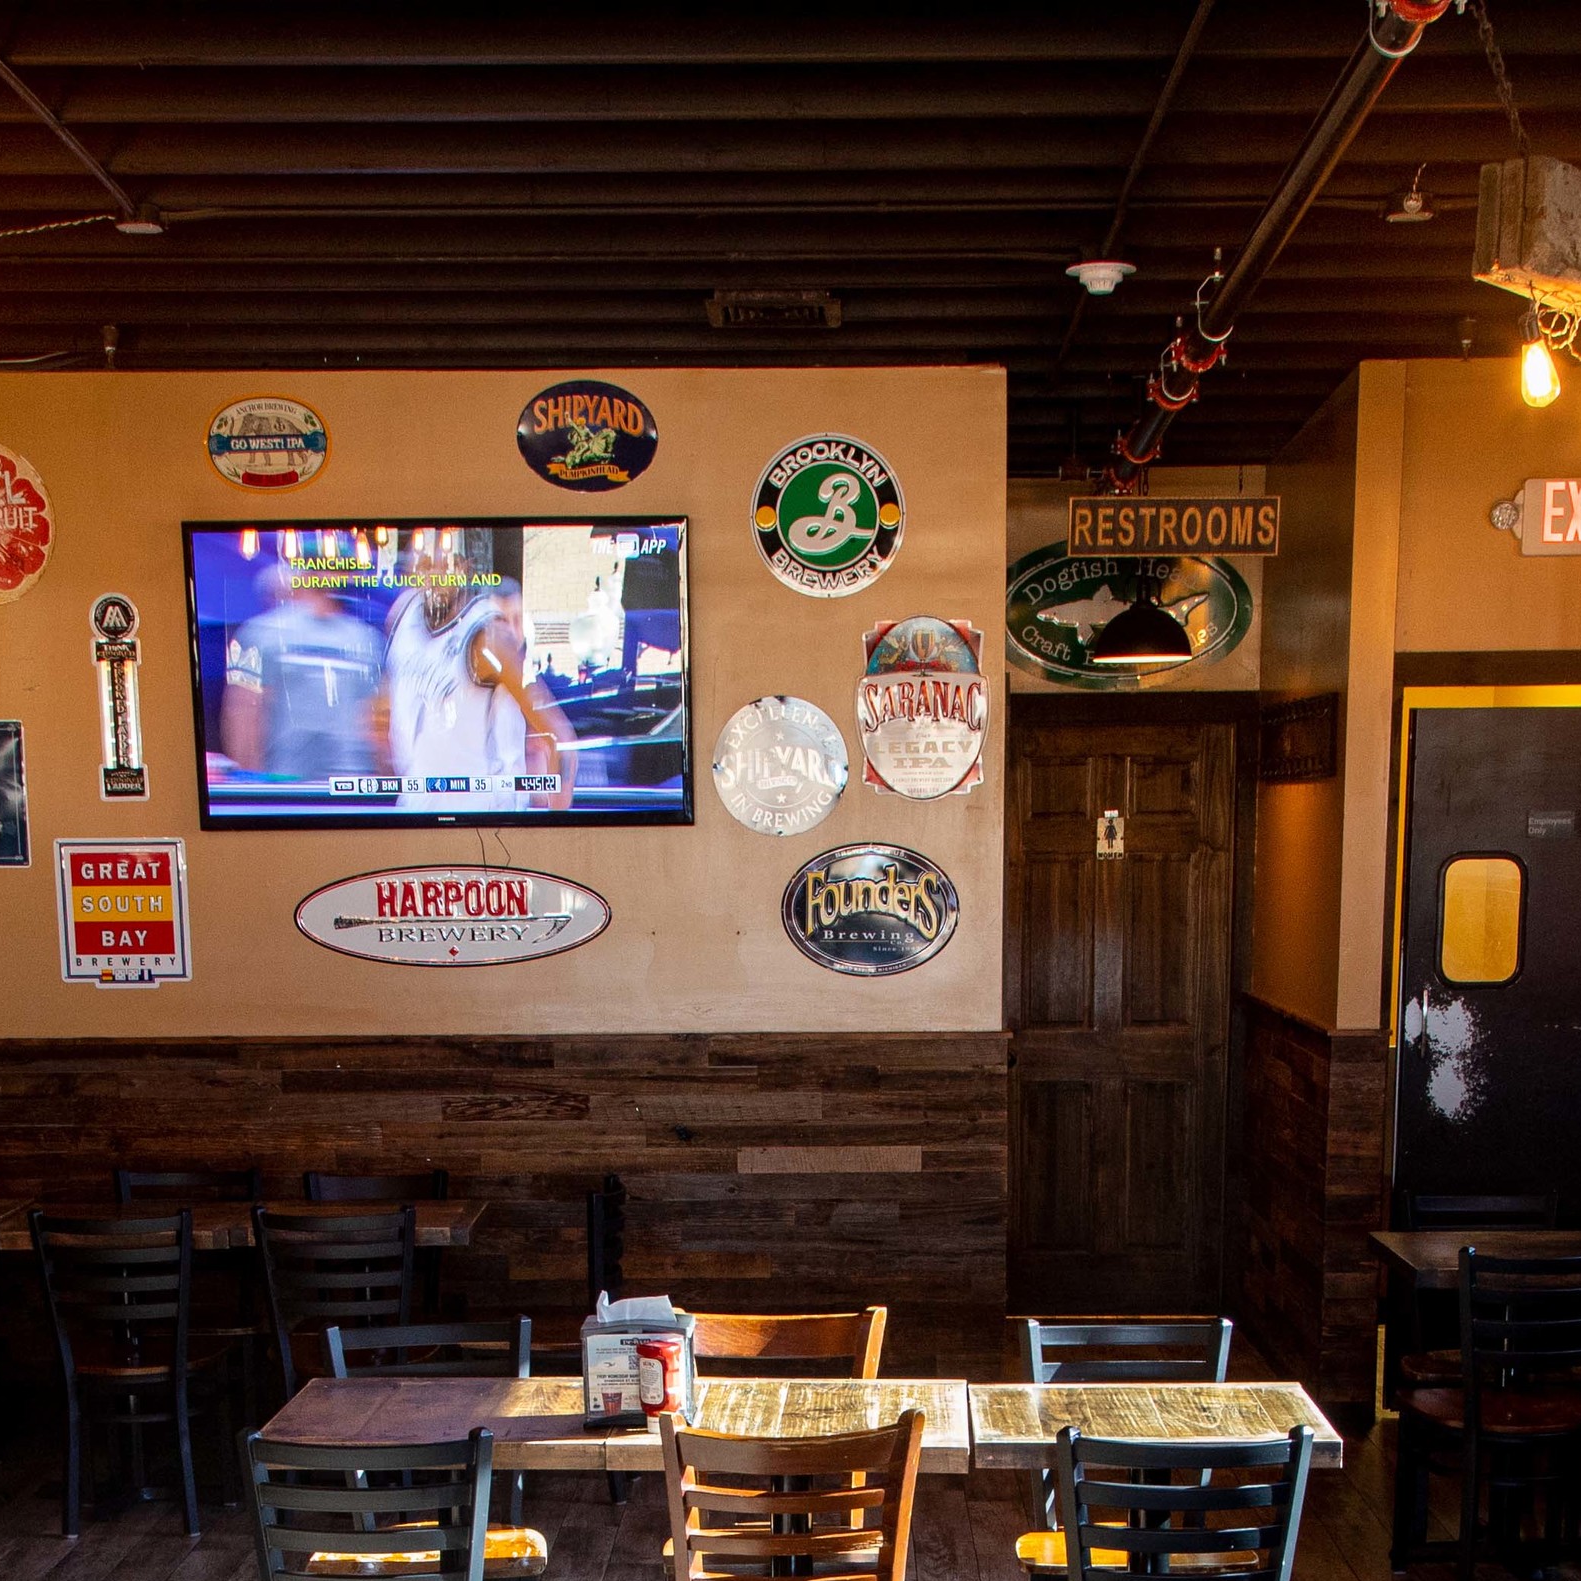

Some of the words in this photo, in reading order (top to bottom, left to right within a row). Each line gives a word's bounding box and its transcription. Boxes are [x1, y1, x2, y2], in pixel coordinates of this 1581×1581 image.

[236, 403, 263, 415] ANCHOR
[264, 402, 297, 414] BREWING
[533, 395, 644, 437] SHIPYARD
[230, 439, 247, 449] GO
[249, 439, 284, 449] WEST!
[287, 438, 305, 448] IPA
[559, 466, 620, 479] PUMPKINHEAD
[768, 442, 888, 489] BROOKLYN
[1074, 506, 1276, 546] RESTROOMS
[641, 539, 667, 554] APP
[771, 545, 884, 589] BREWERY
[291, 575, 348, 588] DURANT
[353, 575, 379, 588] THE
[383, 574, 425, 588] QUICK
[430, 574, 467, 587] TURN
[471, 573, 502, 586] AND
[1022, 557, 1119, 606] Dogfish
[1022, 625, 1071, 662] Craft
[865, 680, 981, 732] SARANAC
[874, 741, 972, 753] LEGACY
[893, 757, 952, 768] IPA
[336, 782, 353, 790] YES
[382, 780, 399, 791] BKN
[407, 779, 419, 791] 55
[450, 780, 466, 790] MIN
[475, 779, 486, 790] 35
[731, 792, 753, 813] IN
[752, 791, 832, 827] BREWING
[1528, 826, 1547, 835] Only
[81, 862, 160, 879] GREAT
[82, 896, 162, 912] SOUTH
[376, 879, 529, 918] HARPOON
[805, 866, 939, 941] Founders
[101, 930, 147, 946] BAY
[378, 926, 529, 943] BREWERY
[823, 930, 914, 943] Brewing
[76, 957, 176, 966] BREWERY
